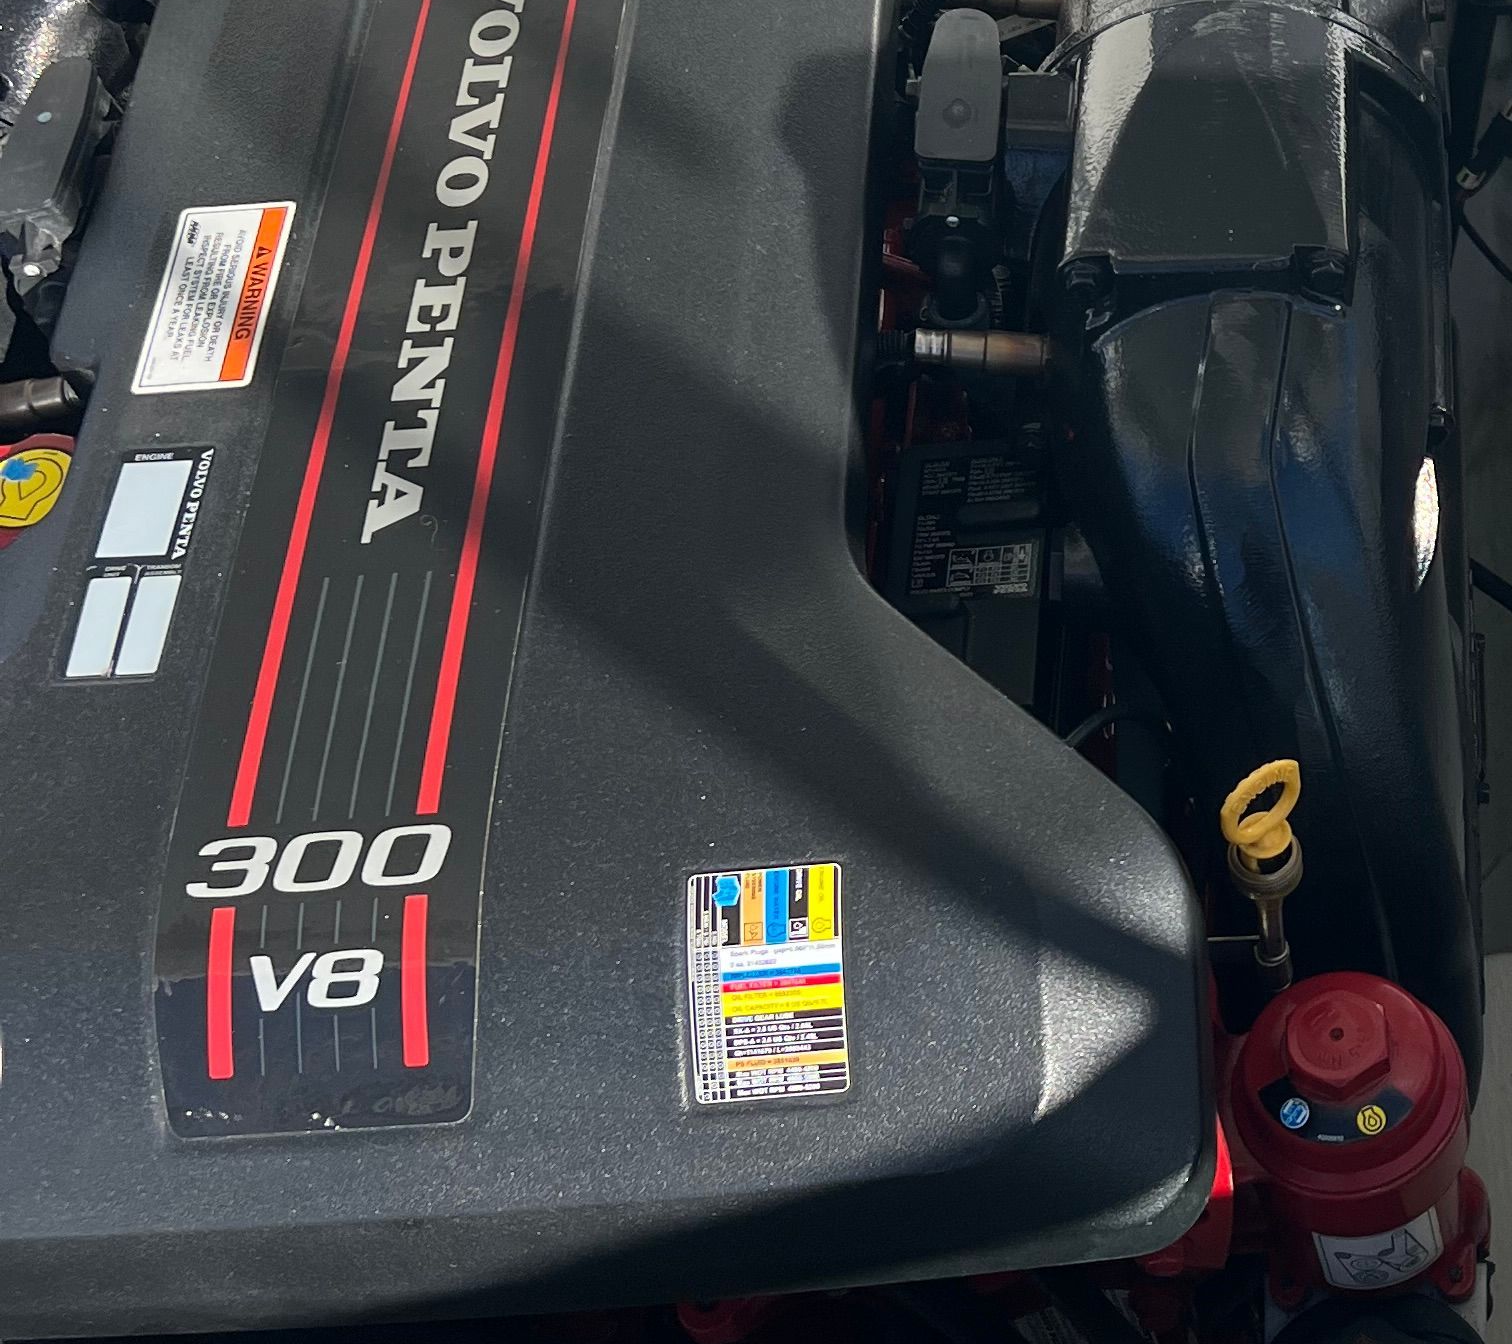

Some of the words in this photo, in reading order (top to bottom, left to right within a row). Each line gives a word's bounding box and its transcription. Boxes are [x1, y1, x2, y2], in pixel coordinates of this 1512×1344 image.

[196, 234, 211, 268] INSPECT
[206, 232, 223, 276] RESULTING
[234, 228, 246, 252] AVOID
[181, 256, 194, 282] LEAST
[219, 243, 231, 267] FROM
[187, 269, 202, 301] SYSTEM
[214, 268, 224, 286] FIRE
[225, 254, 239, 289] SERIOUS
[175, 283, 187, 306] ONCE
[199, 276, 211, 300] FROM
[210, 287, 219, 300] OR
[234, 262, 267, 340] WARNING
[182, 303, 193, 320] FOR
[217, 290, 230, 319] INJURY
[189, 301, 204, 337] LEAKING
[197, 301, 215, 348] EXPLOSION
[213, 320, 222, 332] OR
[174, 321, 188, 349] LEAKS
[205, 334, 218, 362] DEATH
[171, 350, 180, 360] AT
[360, 220, 478, 544] PENTA
[134, 452, 175, 462] ENGINE
[190, 448, 215, 499] VOLVO
[170, 500, 200, 560] PENTA
[185, 824, 452, 898] 300
[249, 948, 384, 1012] V8
